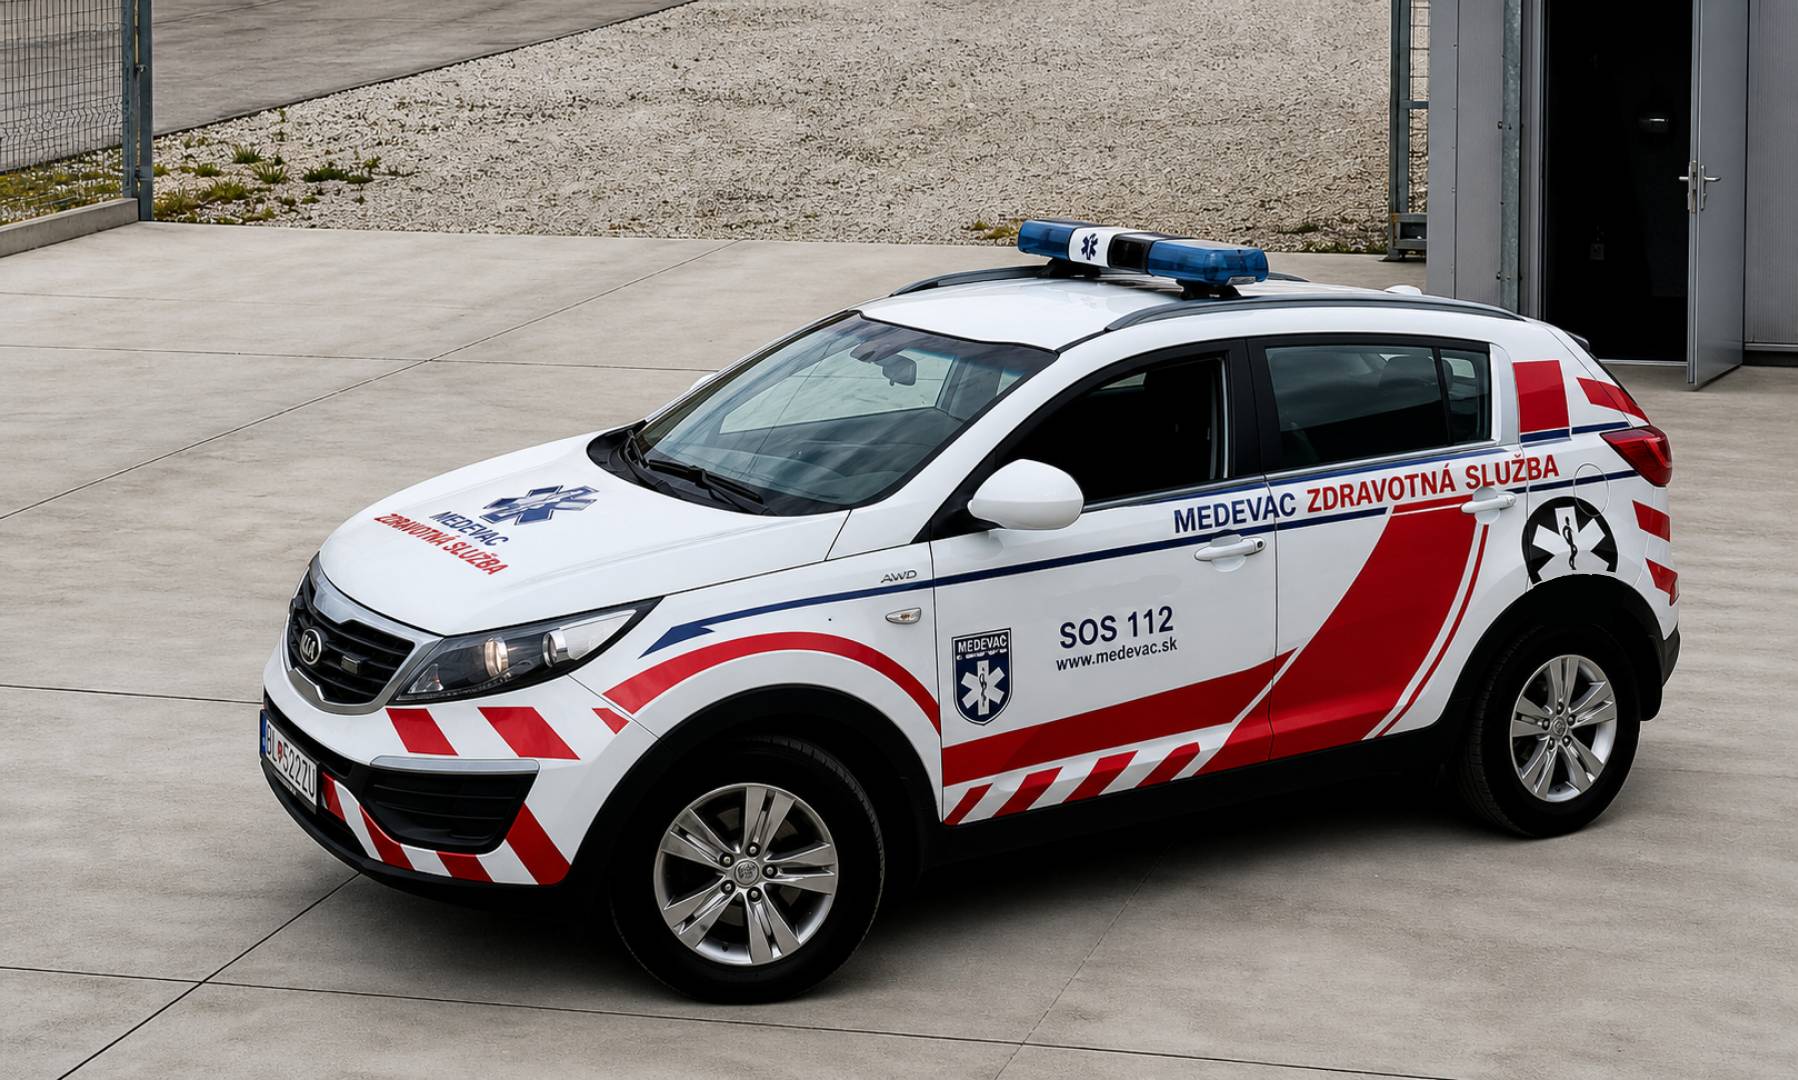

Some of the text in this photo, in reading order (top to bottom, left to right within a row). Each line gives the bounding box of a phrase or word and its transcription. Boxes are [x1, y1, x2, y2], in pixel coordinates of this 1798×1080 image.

[1173, 453, 1560, 534] MEDEVAC ZDRAVOTNÁ SLUŽBA
[429, 511, 509, 547] MEDEVAC
[444, 541, 509, 575] SLUŽBA
[880, 569, 917, 583] AWD
[958, 634, 1007, 653] MEDEVAC
[1059, 605, 1174, 649] SOS 112
[1056, 636, 1178, 671] www.medevac.sk
